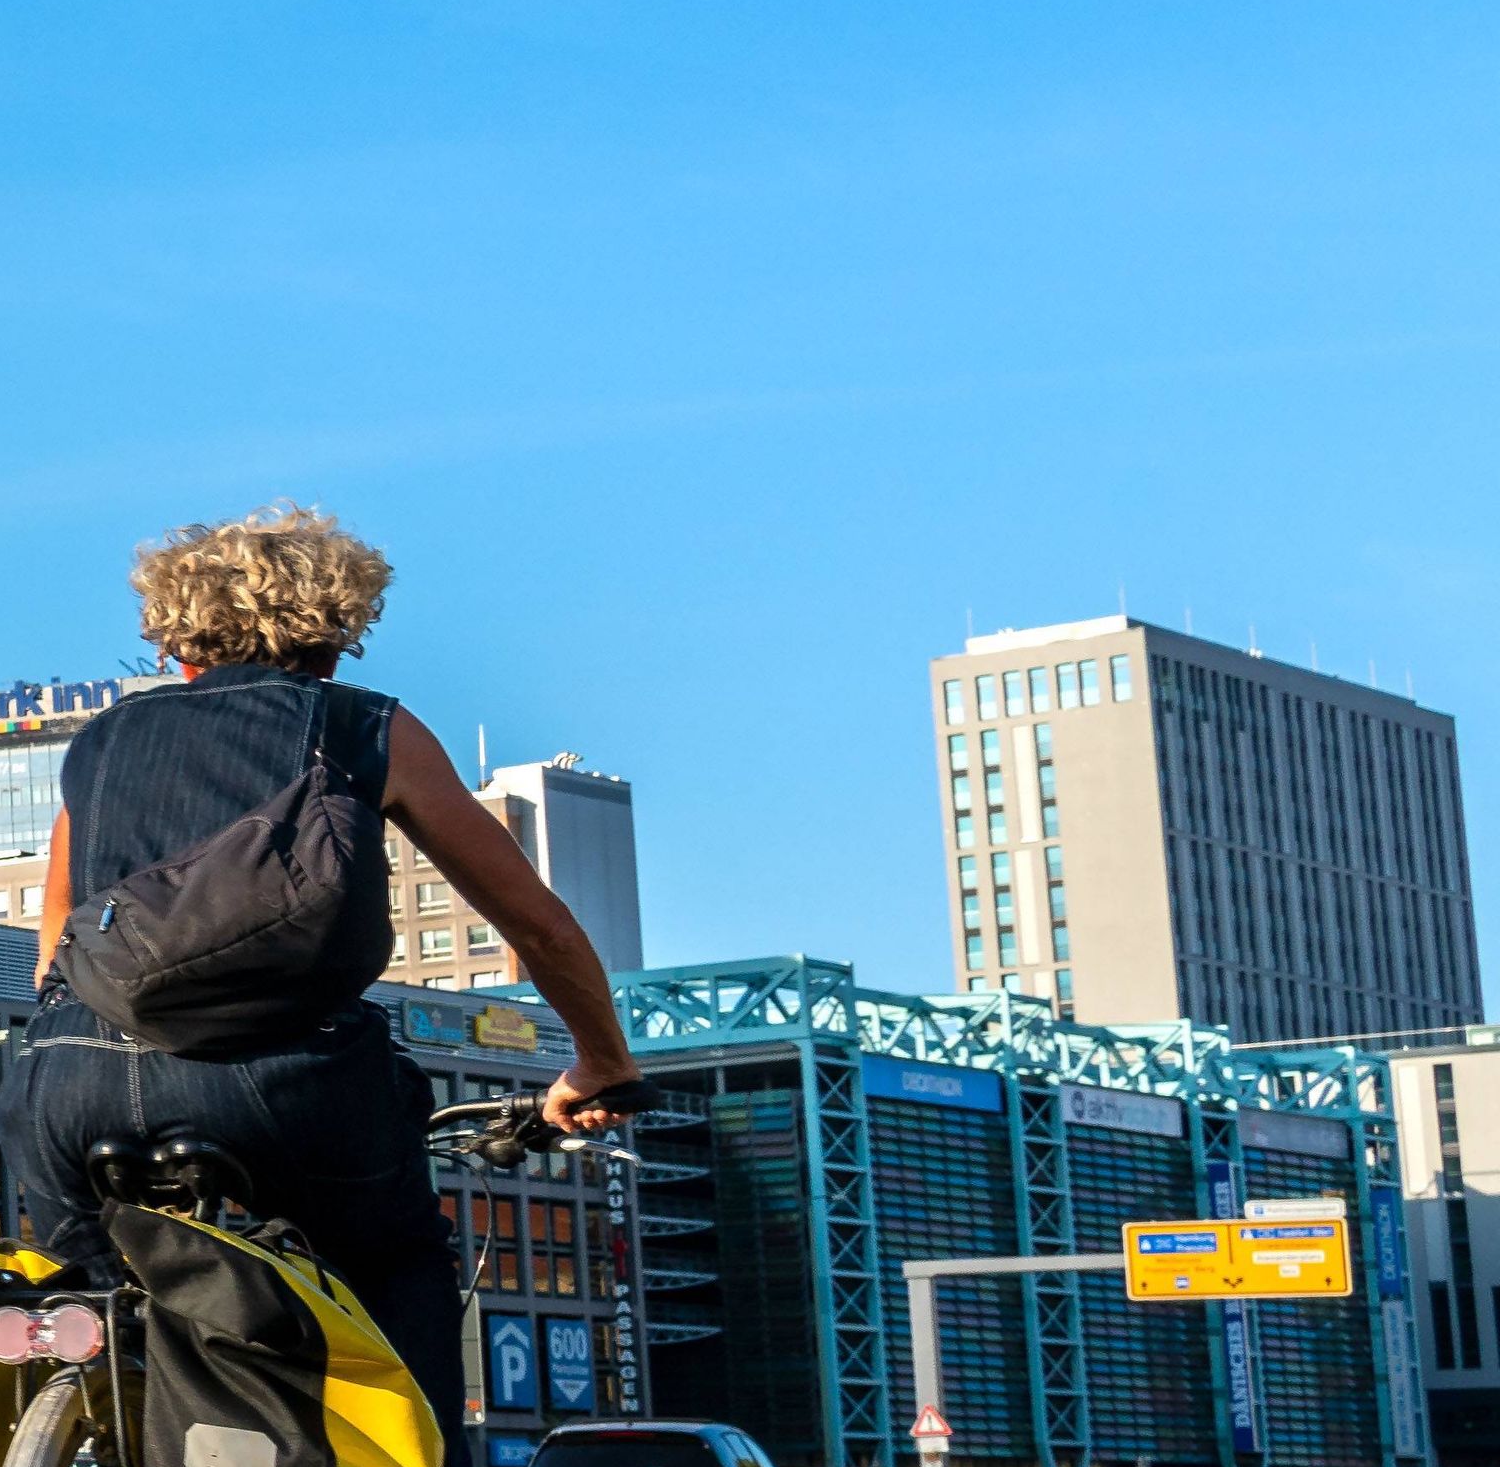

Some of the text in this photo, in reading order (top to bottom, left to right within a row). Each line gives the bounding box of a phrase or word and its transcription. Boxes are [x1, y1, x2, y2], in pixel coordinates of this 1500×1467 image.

[51, 676, 120, 714] inn
[550, 1326, 588, 1361] 600
[614, 1283, 639, 1413] PASSAGEN
[502, 1345, 527, 1401] P
